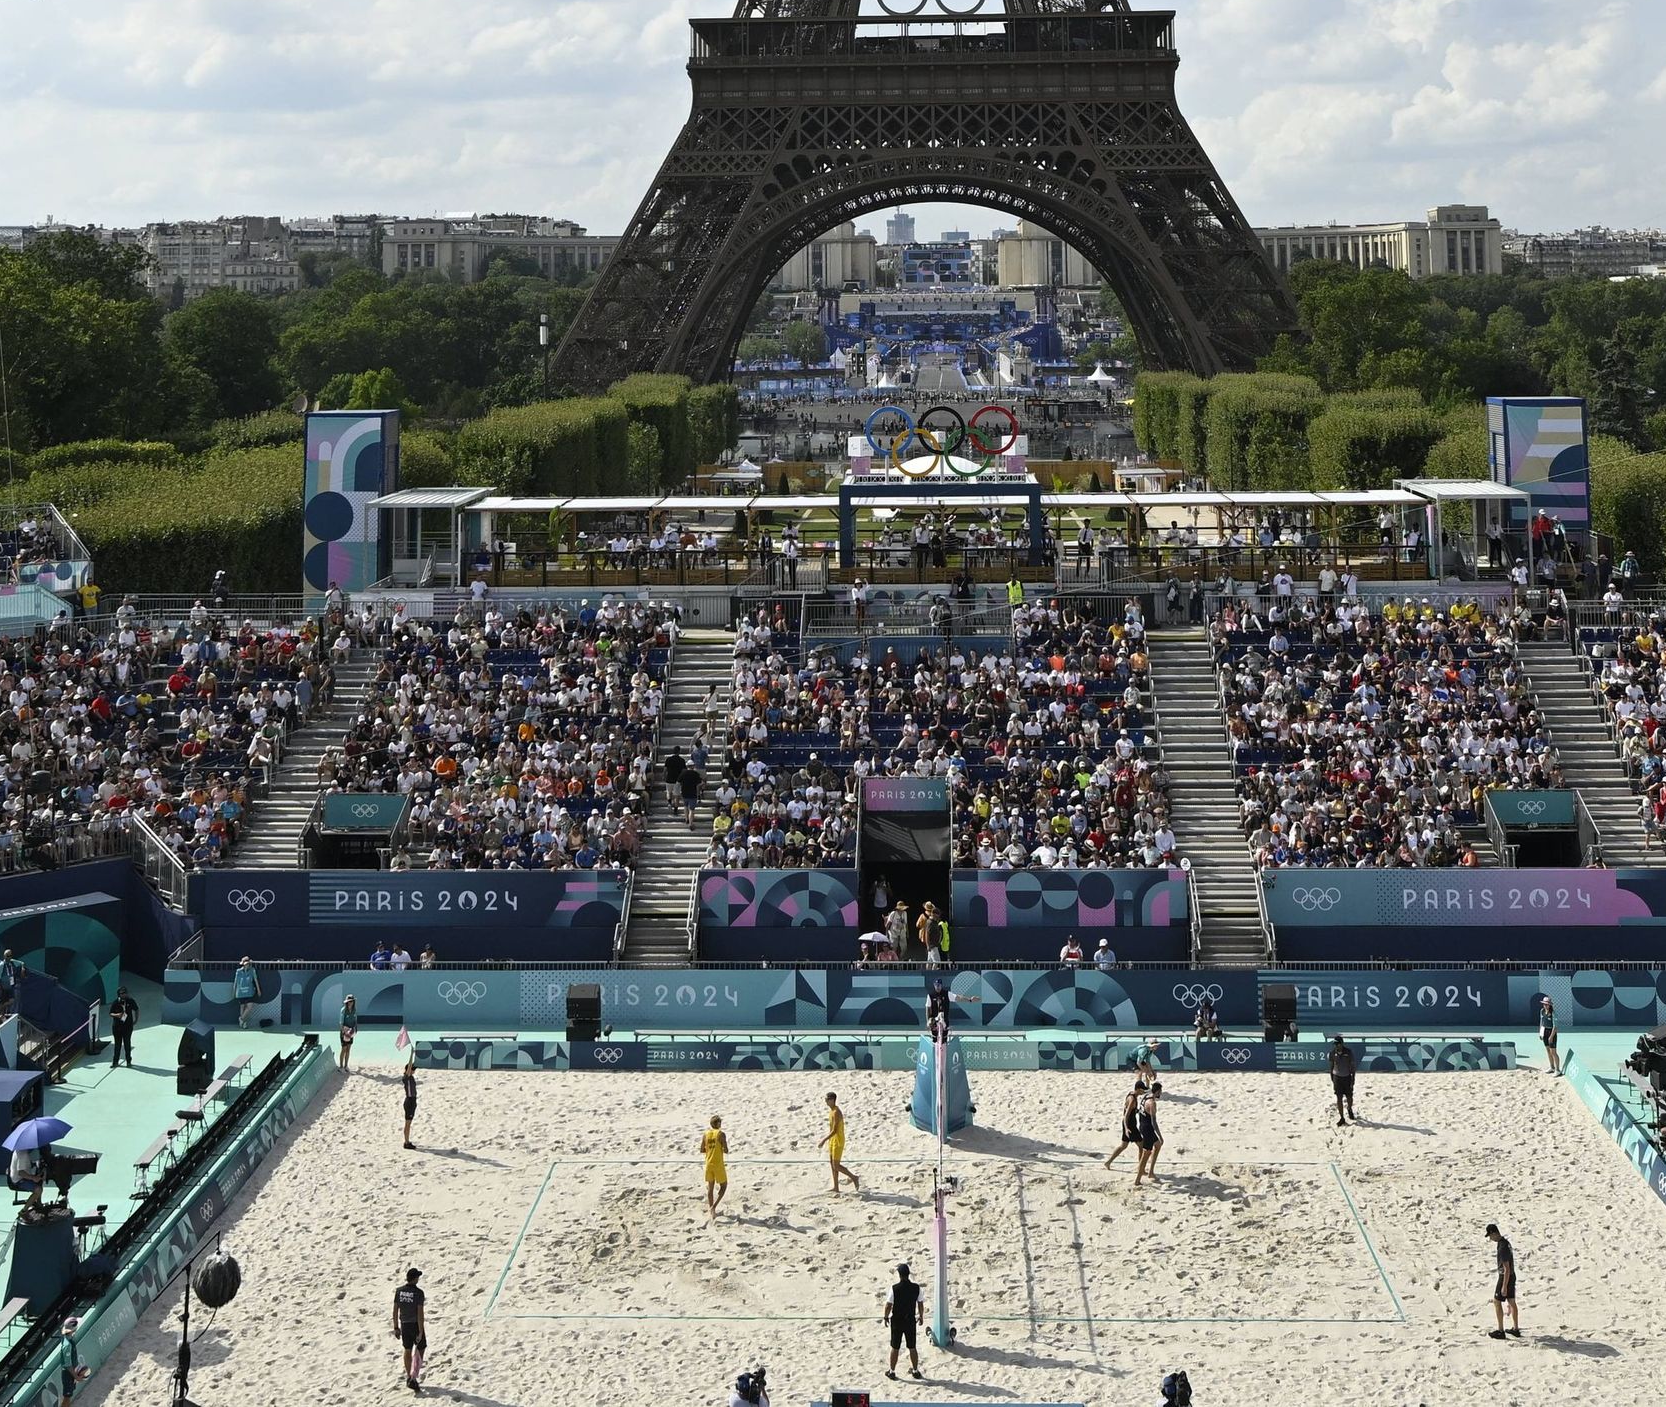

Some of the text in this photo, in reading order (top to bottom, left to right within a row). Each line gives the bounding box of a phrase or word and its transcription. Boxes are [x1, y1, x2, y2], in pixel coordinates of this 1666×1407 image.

[910, 791, 941, 799] 2024
[438, 890, 518, 911] 2024
[1508, 888, 1591, 909] 2024
[655, 984, 738, 1006] 2024
[1396, 985, 1481, 1008] 2024
[690, 1051, 719, 1060] 2024
[1004, 1051, 1032, 1060] 2024
